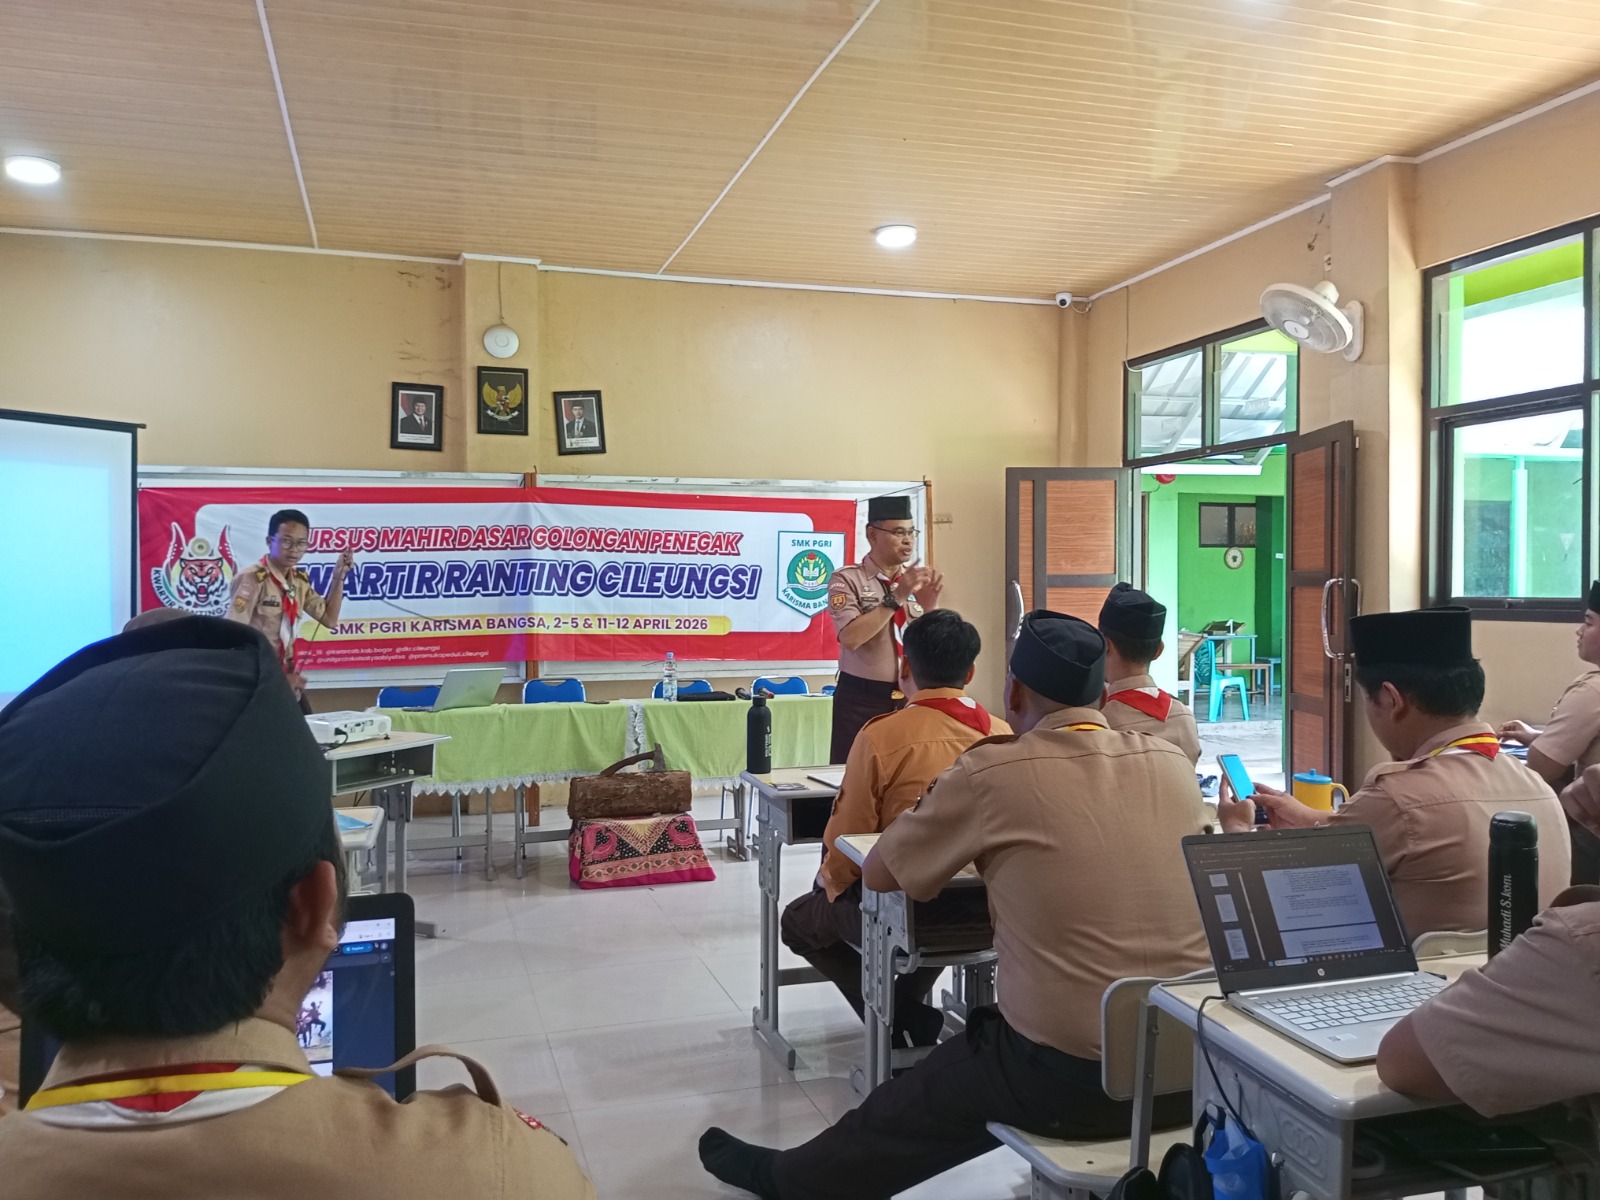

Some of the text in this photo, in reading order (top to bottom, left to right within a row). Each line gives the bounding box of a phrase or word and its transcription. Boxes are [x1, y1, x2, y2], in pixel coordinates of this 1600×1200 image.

[307, 525, 744, 556] URSUS MAHIR DASAR GOLONGAN PENEGAK
[791, 539, 810, 547] SMK
[442, 559, 598, 598] RANTING
[596, 561, 762, 600] CILEUNGSI
[781, 589, 812, 609] KARISMA
[330, 617, 708, 635] SMK PGRI KARISMA BANGSA, 2-5 & 11-12 APRIL 2026
